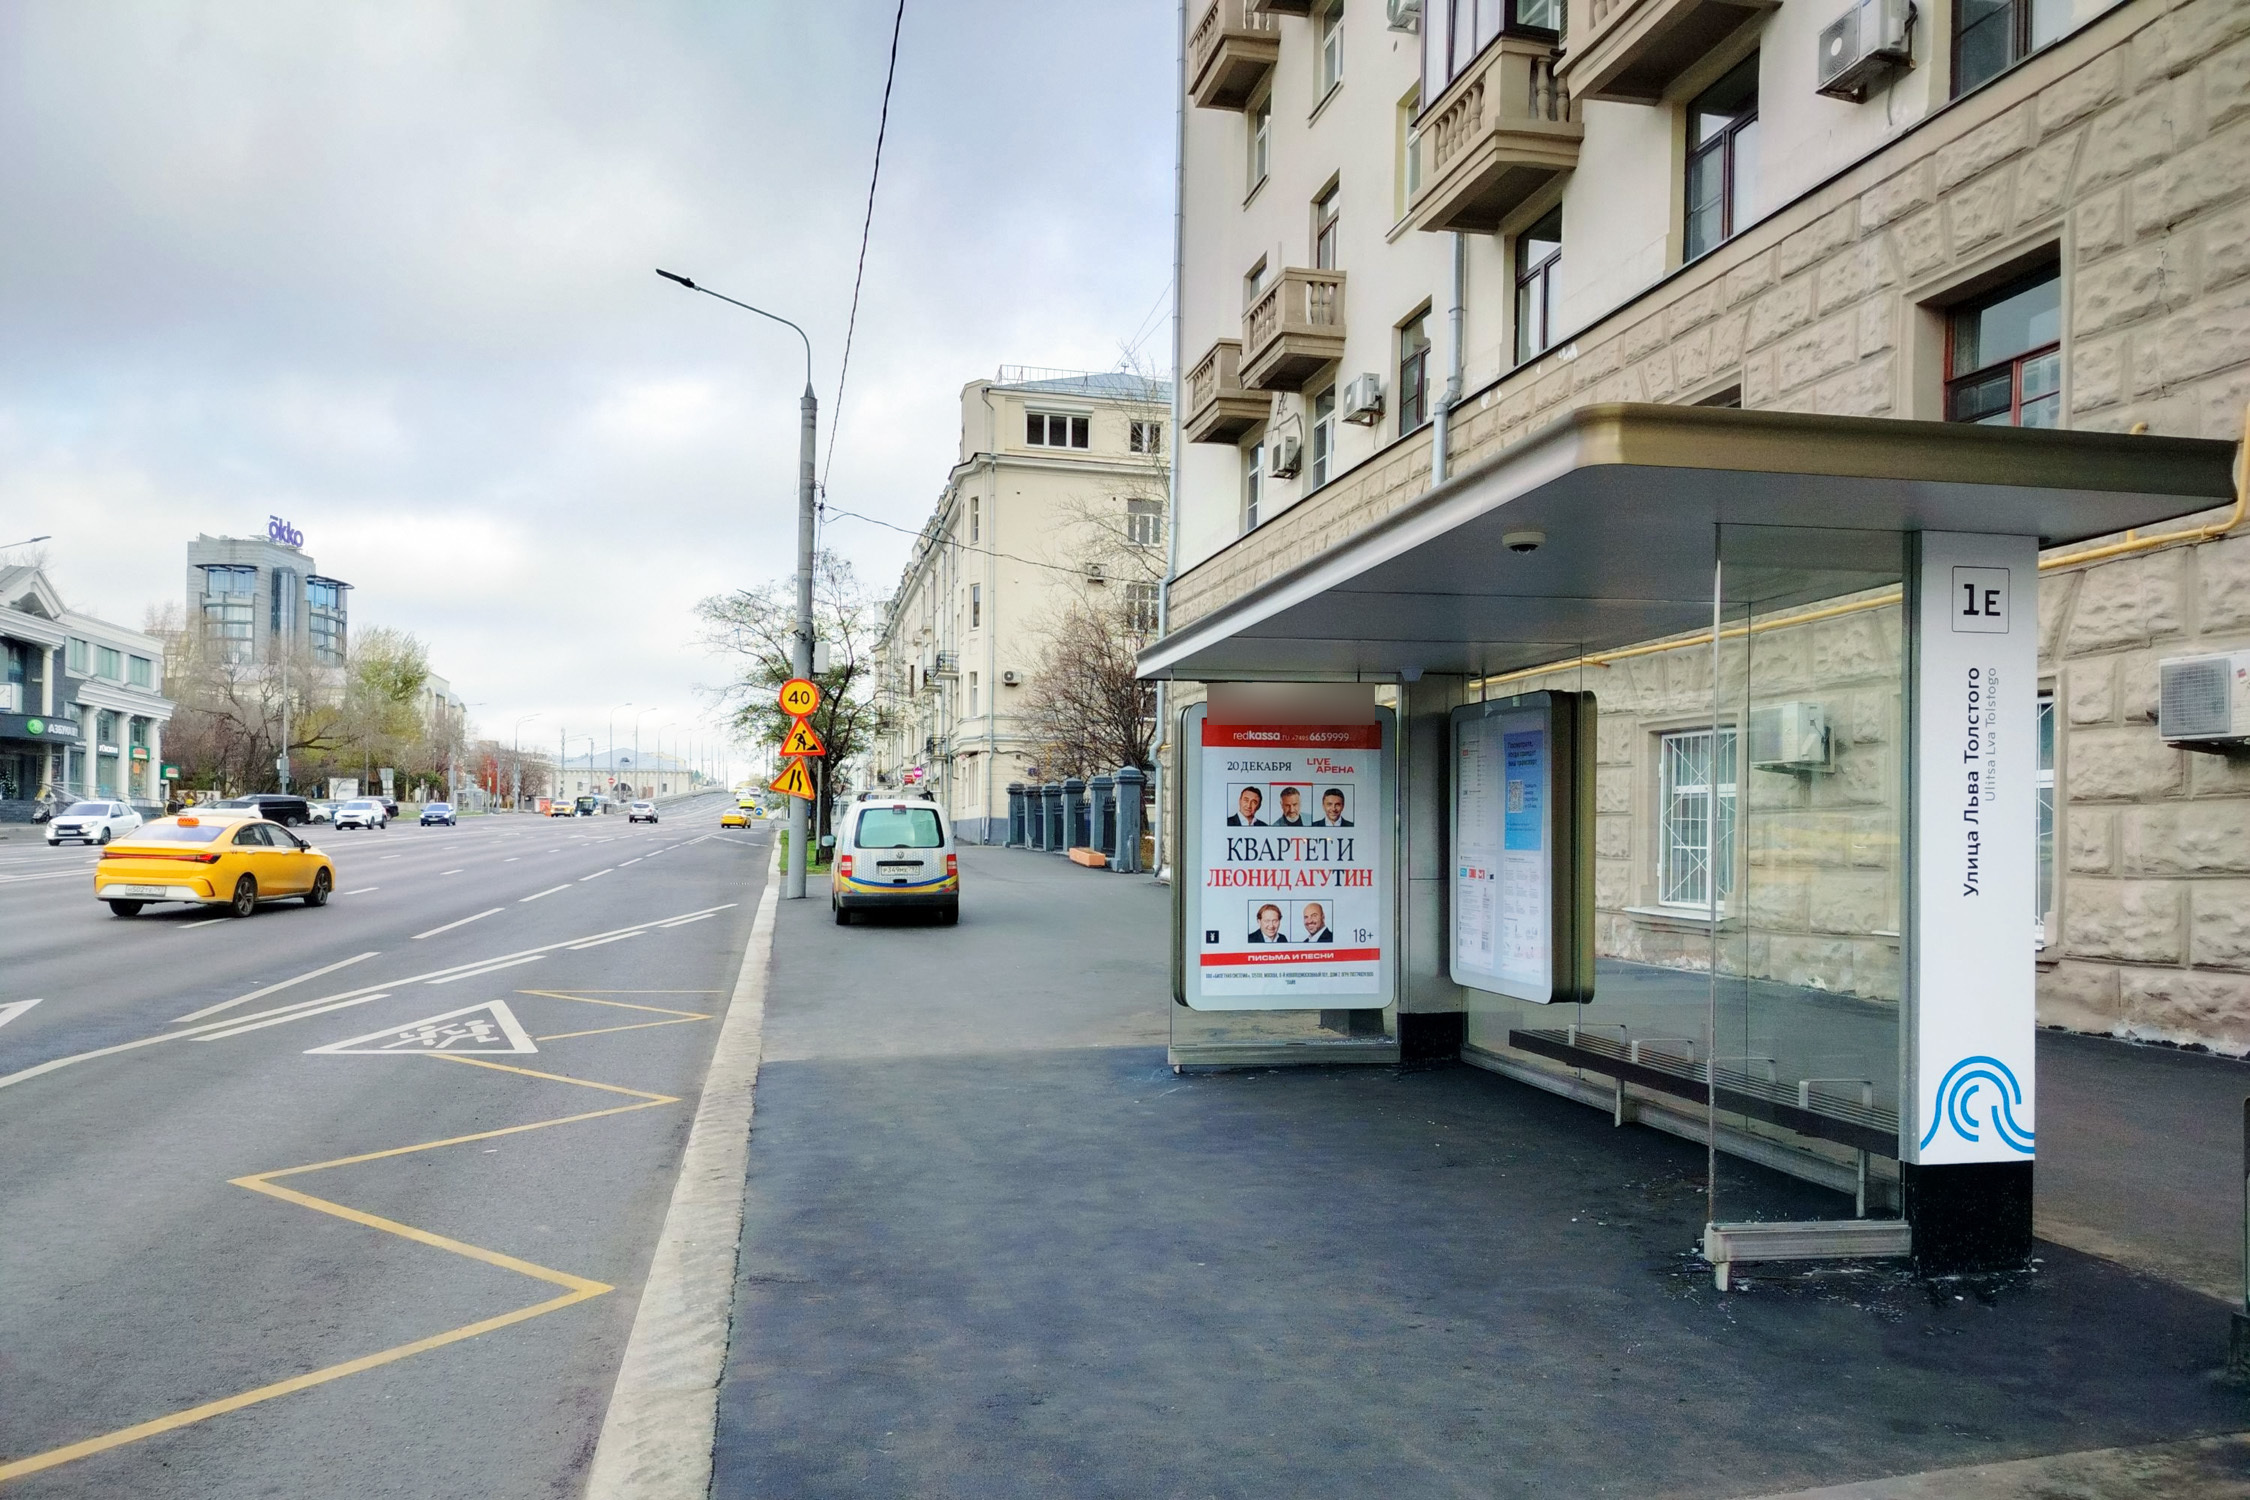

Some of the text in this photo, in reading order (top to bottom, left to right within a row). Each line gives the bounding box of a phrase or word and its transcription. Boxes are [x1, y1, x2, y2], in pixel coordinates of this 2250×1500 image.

[788, 690, 810, 705] 40
[1984, 667, 1999, 802] Ulitsa Lva Tolstogo
[1227, 761, 1292, 774] 20 ДЕКАБРЯ
[1307, 758, 1331, 766] LIVE
[1316, 766, 1355, 774] АРЕНА
[1963, 667, 1981, 897] Улица Льва Толстого
[1226, 837, 1355, 862] КВАРТЕТ И
[1207, 869, 1374, 891] ЛЕОНИД АГУТИН
[1353, 928, 1374, 943] 18+
[1247, 954, 1291, 962] ПИСЬМА
[1300, 952, 1335, 960] ПЕСНИ
